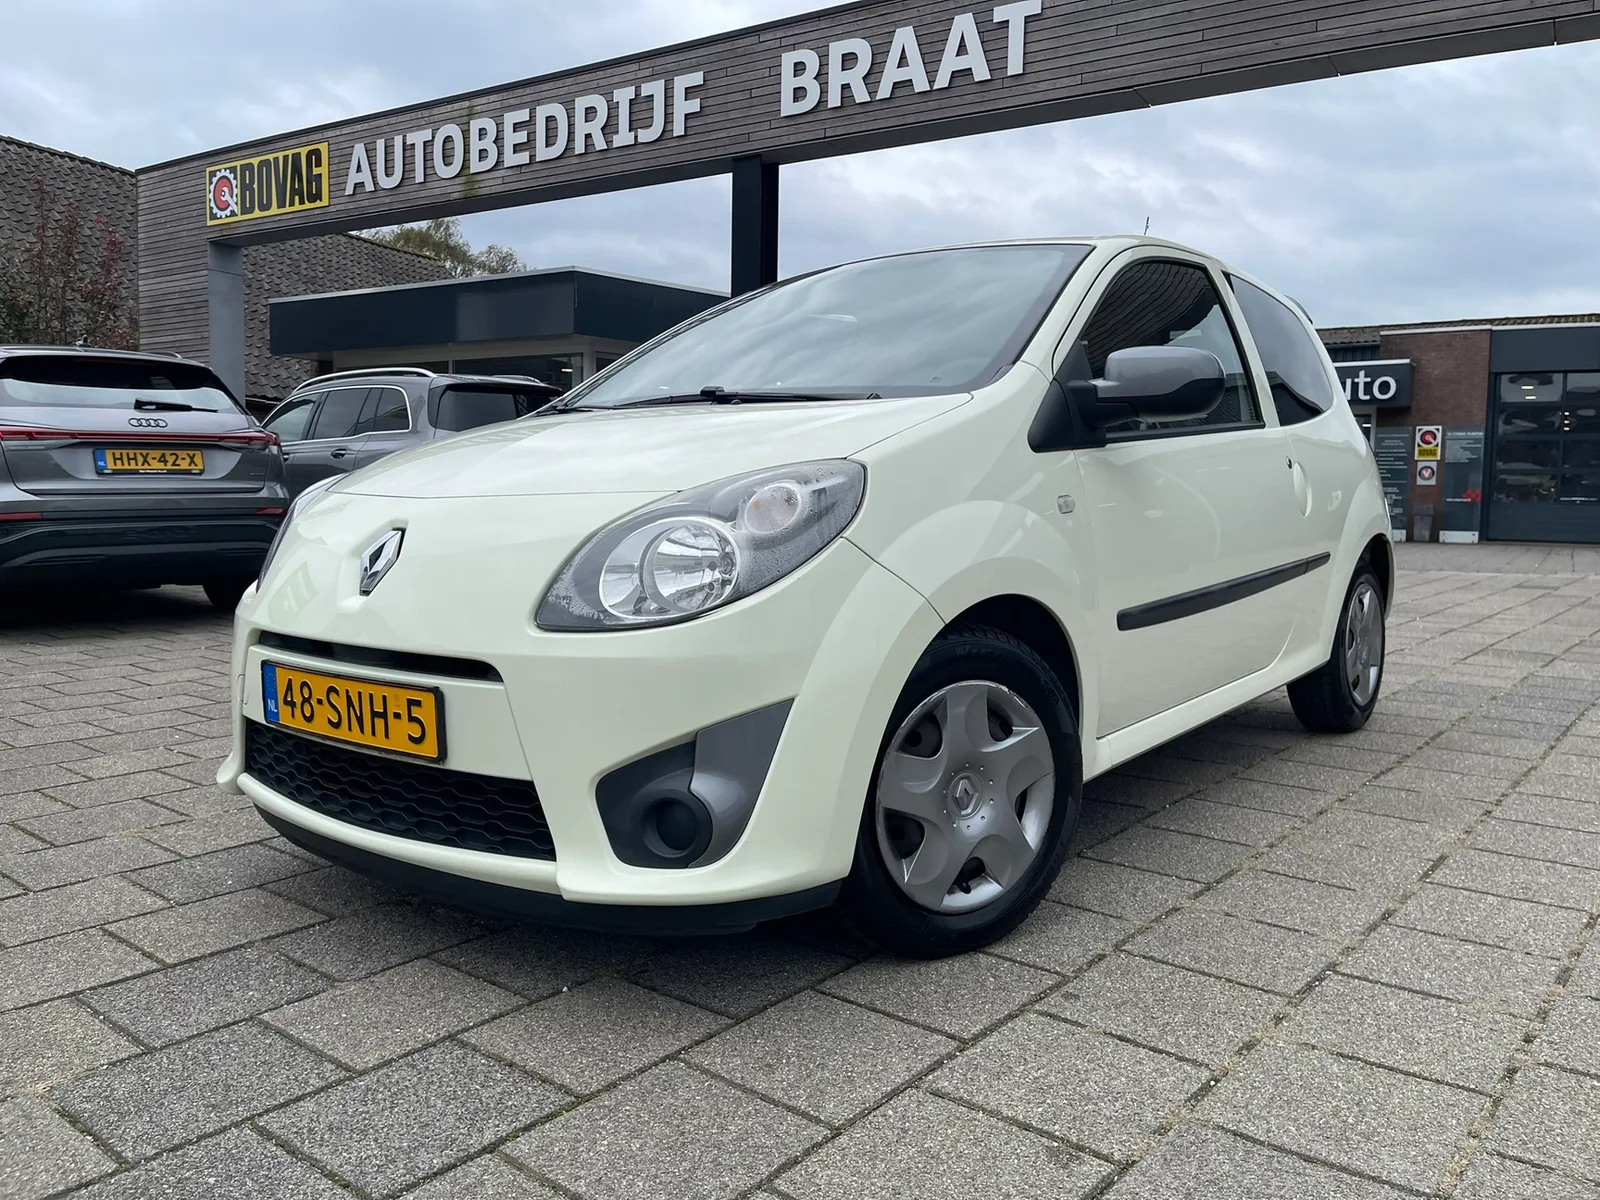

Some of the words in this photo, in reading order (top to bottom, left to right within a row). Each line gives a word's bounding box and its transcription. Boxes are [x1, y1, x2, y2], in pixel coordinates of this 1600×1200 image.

[344, 71, 704, 196] AUTOBEDRIJF
[780, 0, 1042, 117] BRAAT
[239, 147, 323, 215] BOVAG
[112, 452, 199, 467] HHX-42-X
[267, 699, 278, 712] NL
[282, 677, 427, 745] 48-SNH-5
